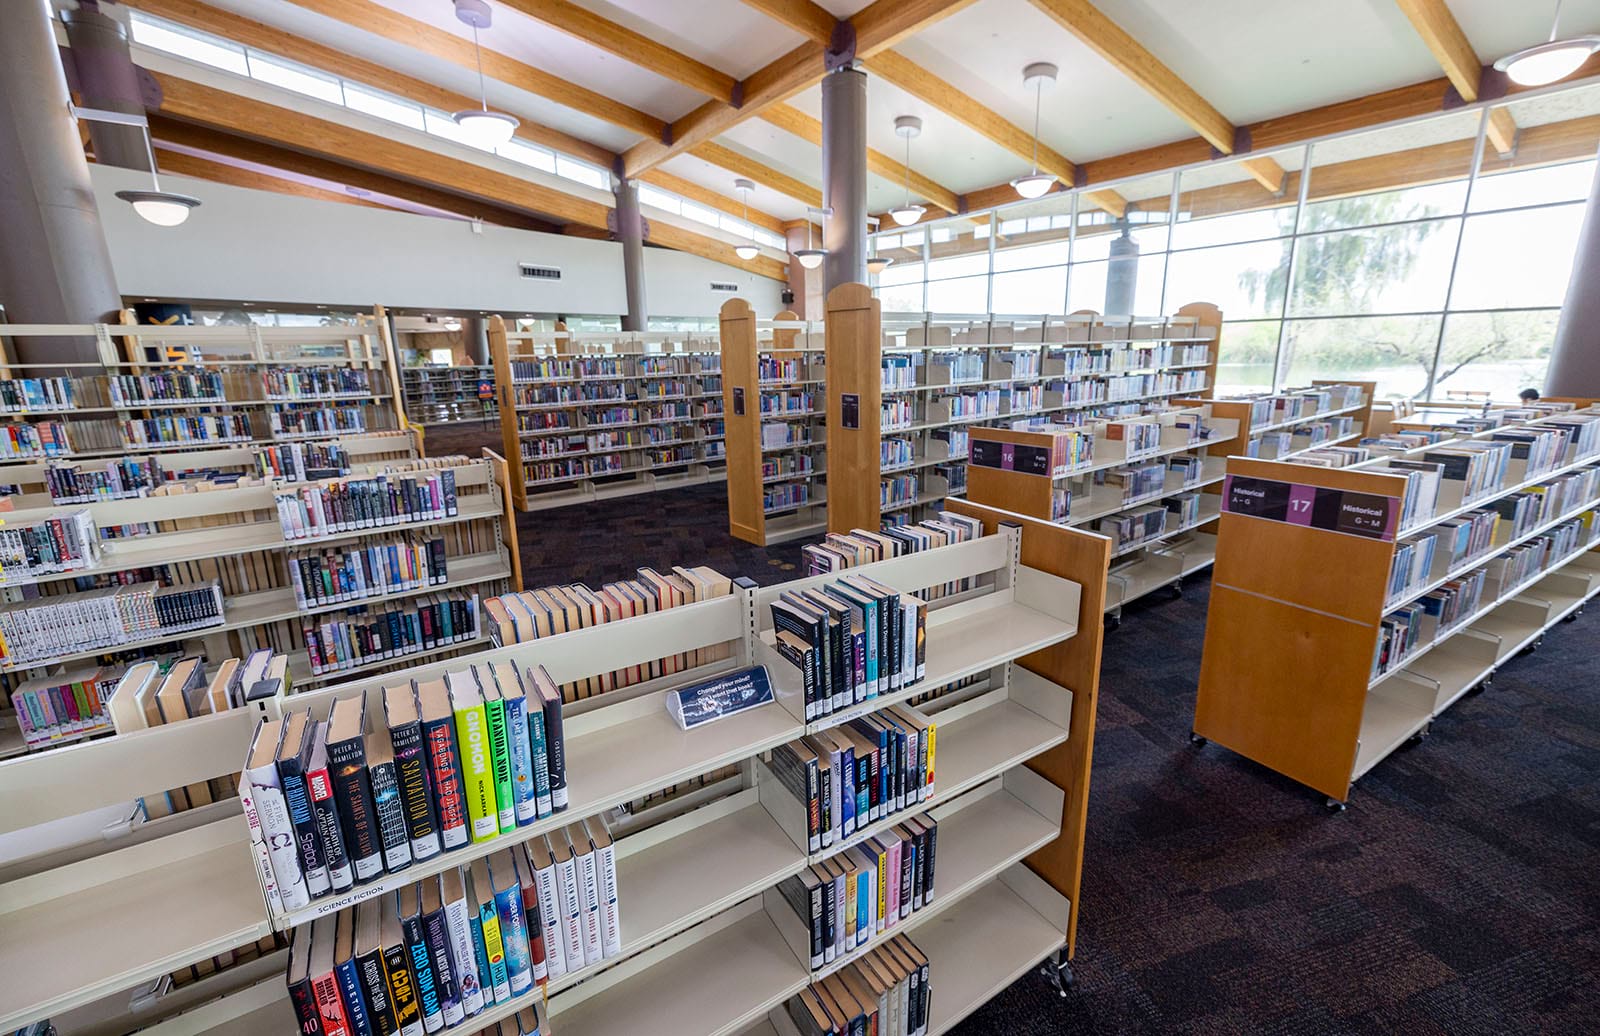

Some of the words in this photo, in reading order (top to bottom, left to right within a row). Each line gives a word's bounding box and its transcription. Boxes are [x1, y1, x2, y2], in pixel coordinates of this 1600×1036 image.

[1003, 453, 1013, 462] 16
[1234, 487, 1264, 498] Historical
[1292, 499, 1310, 512] 17
[1342, 504, 1382, 516] Historical
[842, 610, 851, 657] HOLDOUT
[698, 684, 721, 696] Changed
[721, 681, 734, 690] your
[735, 675, 750, 684] mind?
[738, 682, 754, 692] book?
[394, 730, 410, 739] PETER
[490, 705, 506, 758] TITANIUM
[334, 744, 352, 756] PETER
[394, 735, 420, 748] HAMILTON
[465, 712, 484, 774] GNOMON
[334, 750, 363, 764] HAMILTON
[435, 728, 448, 771] VAGABONDS
[444, 780, 453, 796] HAO
[497, 758, 508, 784] NOIR
[284, 776, 300, 790] JOE
[310, 776, 326, 802] MARVEL
[348, 780, 360, 795] THE
[402, 760, 429, 820] SALVATION
[262, 800, 276, 830] SERMON
[274, 804, 284, 824] FIRE
[286, 786, 311, 825] HALDEMAN
[351, 795, 364, 820] SAINTS
[246, 808, 260, 830] SCRIBE
[323, 811, 335, 826] THE
[316, 807, 328, 838] CAPTAIN
[323, 834, 336, 865] AMERICA
[326, 825, 341, 847] DEATH
[414, 822, 432, 838] LO
[332, 846, 342, 856] OF
[543, 890, 552, 901] NEW
[587, 889, 595, 906] WORLD
[606, 882, 614, 898] WORLD
[838, 887, 846, 908] LINE
[318, 896, 352, 914] SCIENCE
[353, 886, 384, 902] FICTION
[568, 895, 577, 913] WORLD
[545, 903, 554, 920] WORLD
[409, 940, 430, 969] ZERO
[362, 960, 378, 986] ACROSS
[415, 967, 435, 993] SUM
[370, 984, 380, 996] THE
[347, 984, 366, 1029] RETURN
[372, 994, 386, 1012] SAND
[421, 991, 440, 1017] GAM
[304, 1018, 318, 1034] 40
